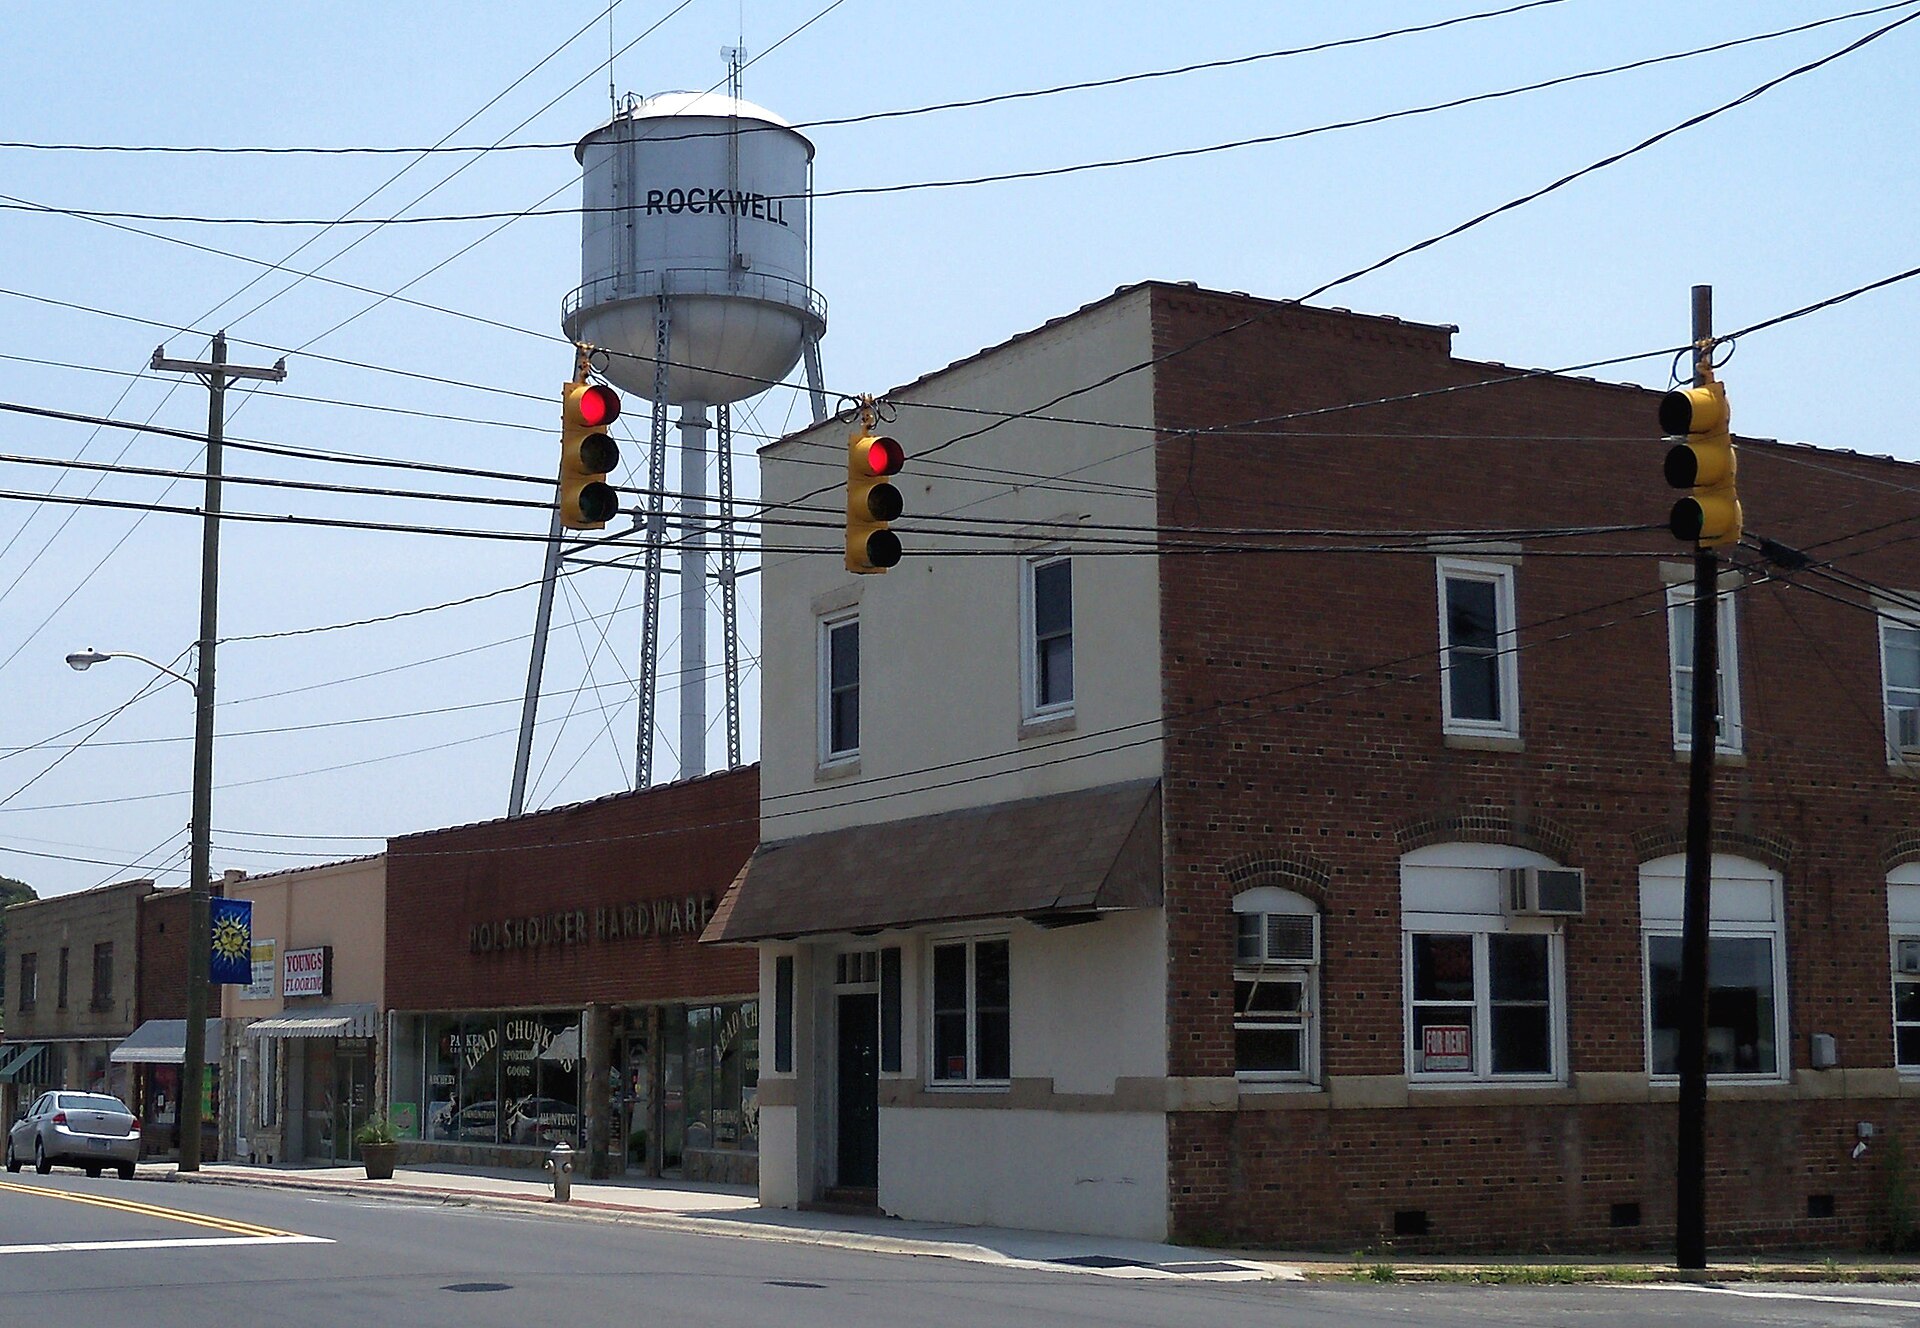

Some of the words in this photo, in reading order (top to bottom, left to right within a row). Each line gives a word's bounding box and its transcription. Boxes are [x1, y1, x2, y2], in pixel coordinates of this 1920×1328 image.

[646, 188, 789, 226] ROCKWELL
[469, 910, 587, 950] HOLSHOUSER
[595, 896, 714, 940] HARDWARE
[286, 953, 323, 973] YOUNGS
[285, 976, 322, 992] FLOORING
[450, 1034, 482, 1047] PAKE
[715, 1011, 740, 1062] LEAD
[1426, 1030, 1443, 1054] FOR
[1444, 1030, 1467, 1054] RENT
[465, 1028, 498, 1070] LEAD
[502, 1050, 534, 1061] SPORTI
[506, 1065, 531, 1077] GOODS
